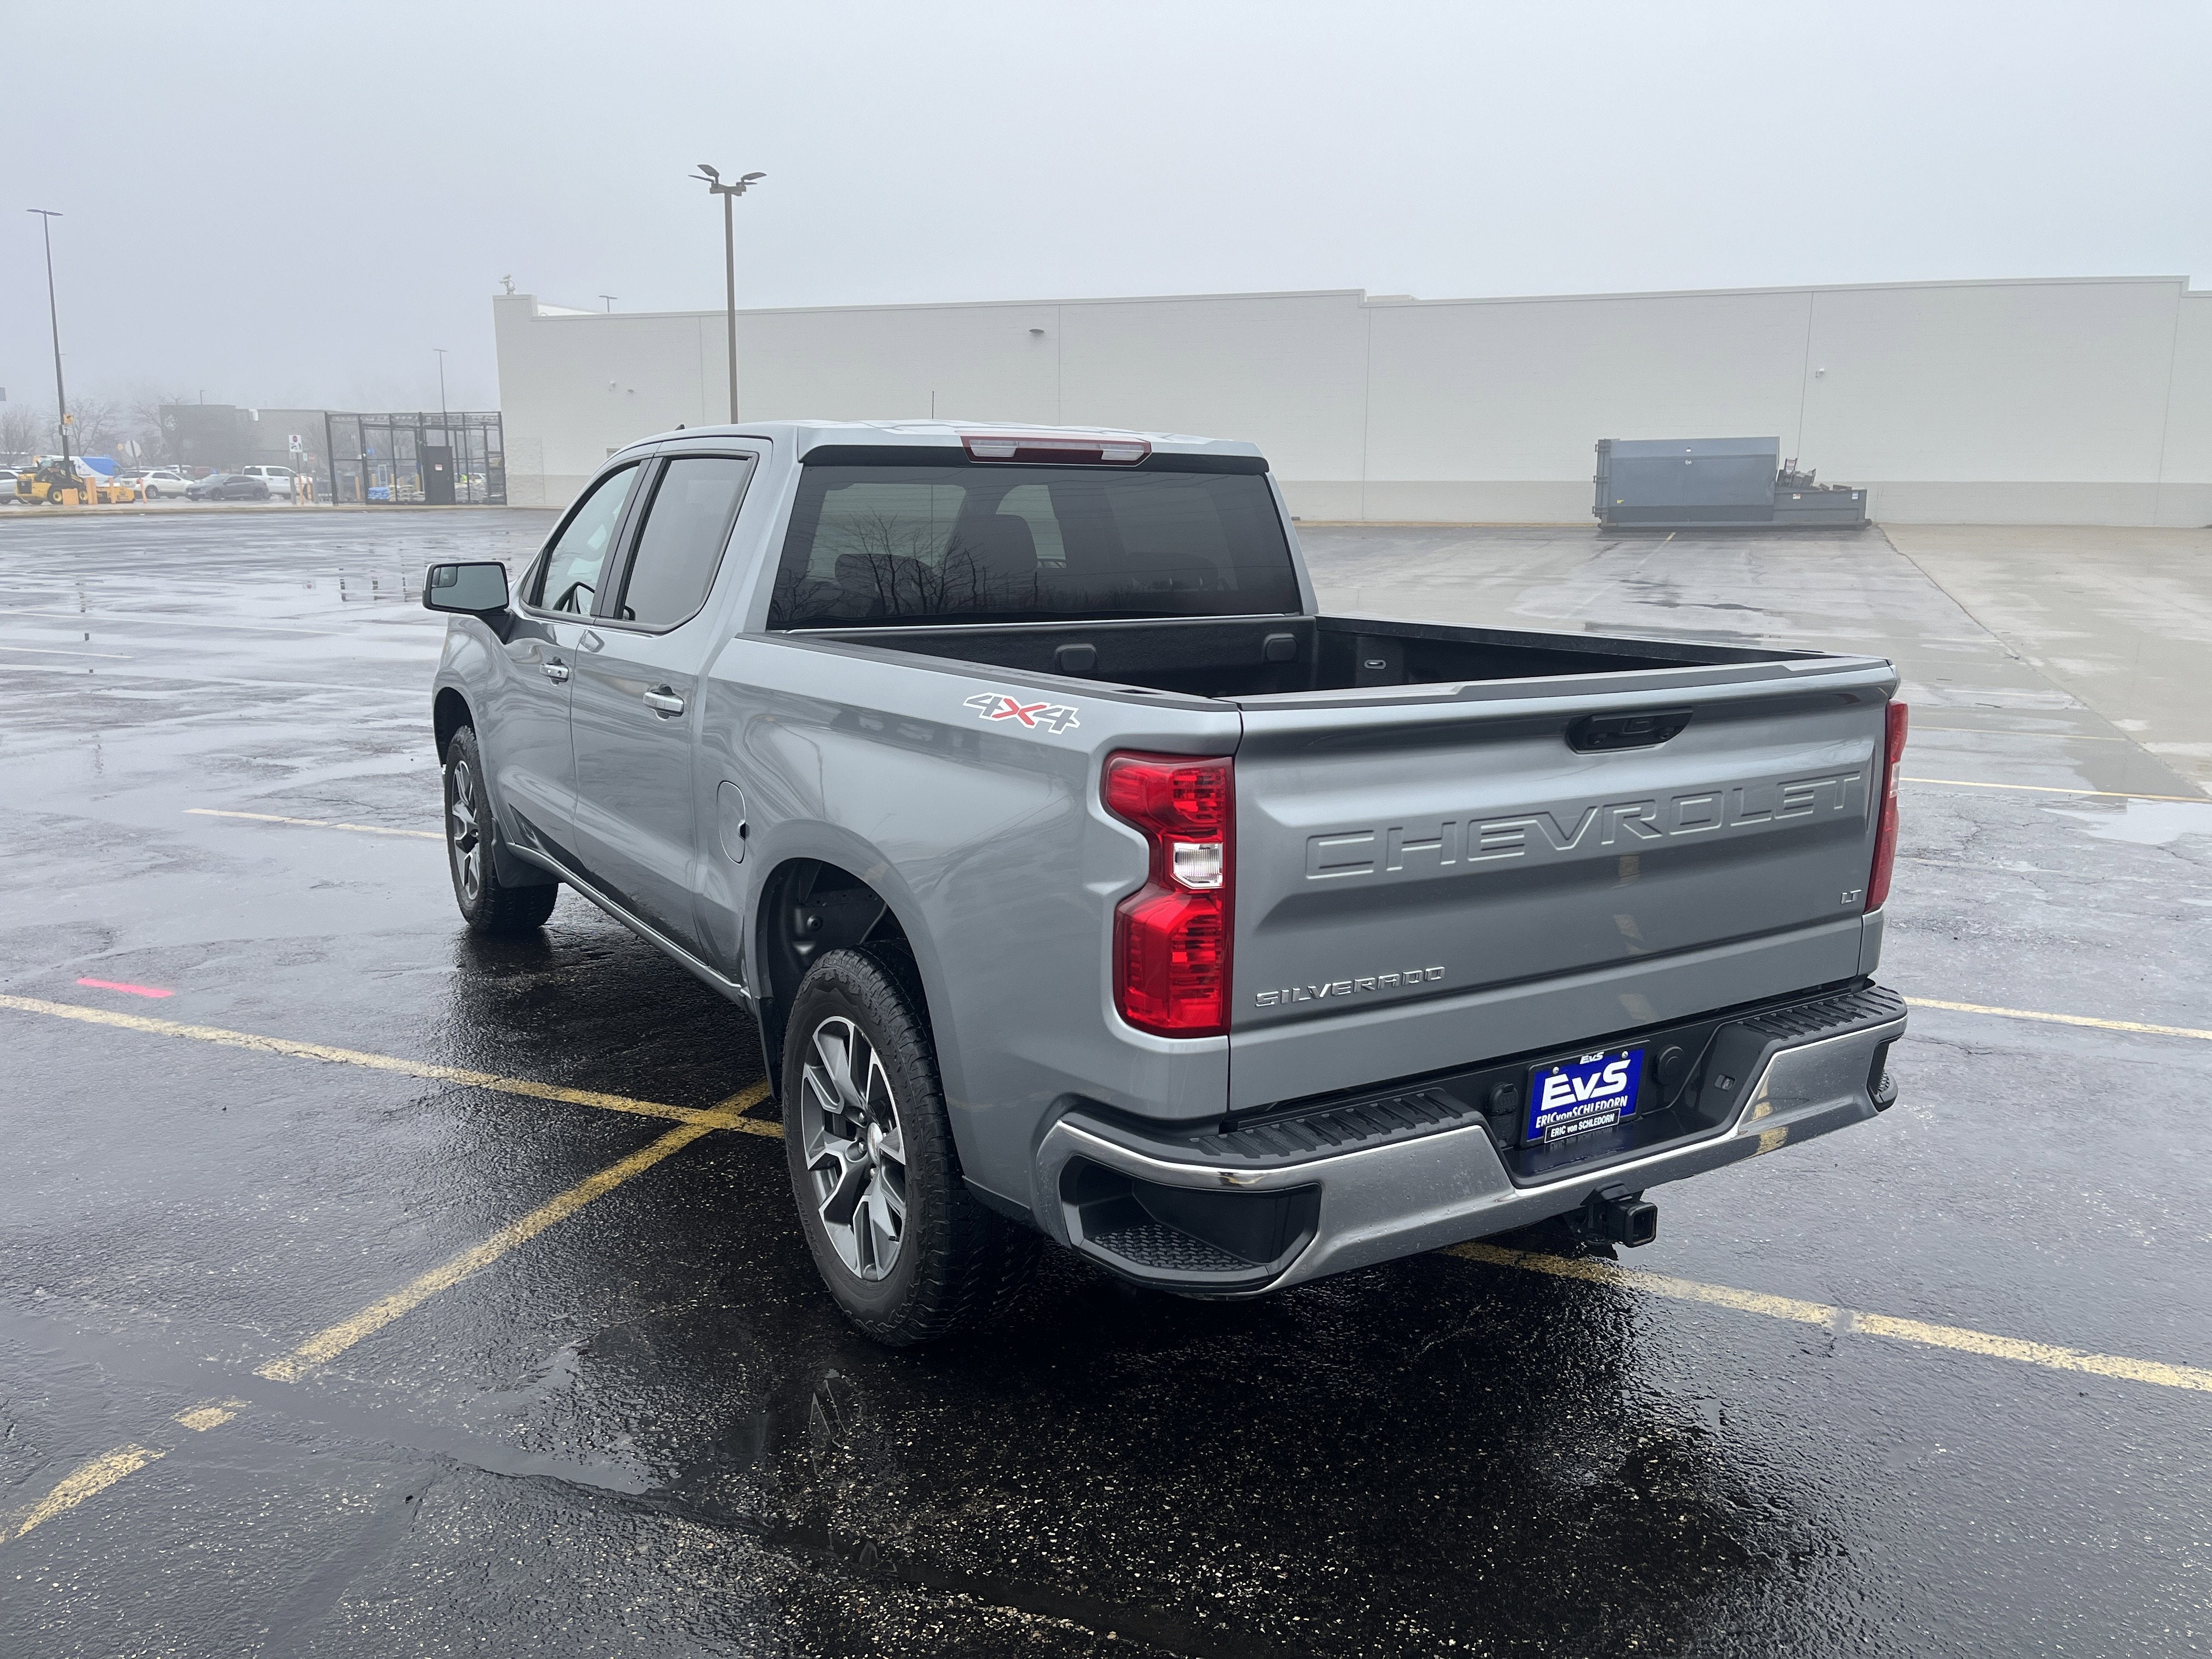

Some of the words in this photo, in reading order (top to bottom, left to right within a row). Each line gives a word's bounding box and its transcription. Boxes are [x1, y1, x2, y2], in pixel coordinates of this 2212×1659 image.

[1305, 770, 1861, 879] CHEVROLET
[1841, 889, 1862, 905] LT
[1255, 966, 1446, 1008] SILVERADO
[1550, 1126, 1566, 1138] ERIC
[1567, 1124, 1577, 1133] von
[1578, 1113, 1616, 1130] SCHLEDORN
